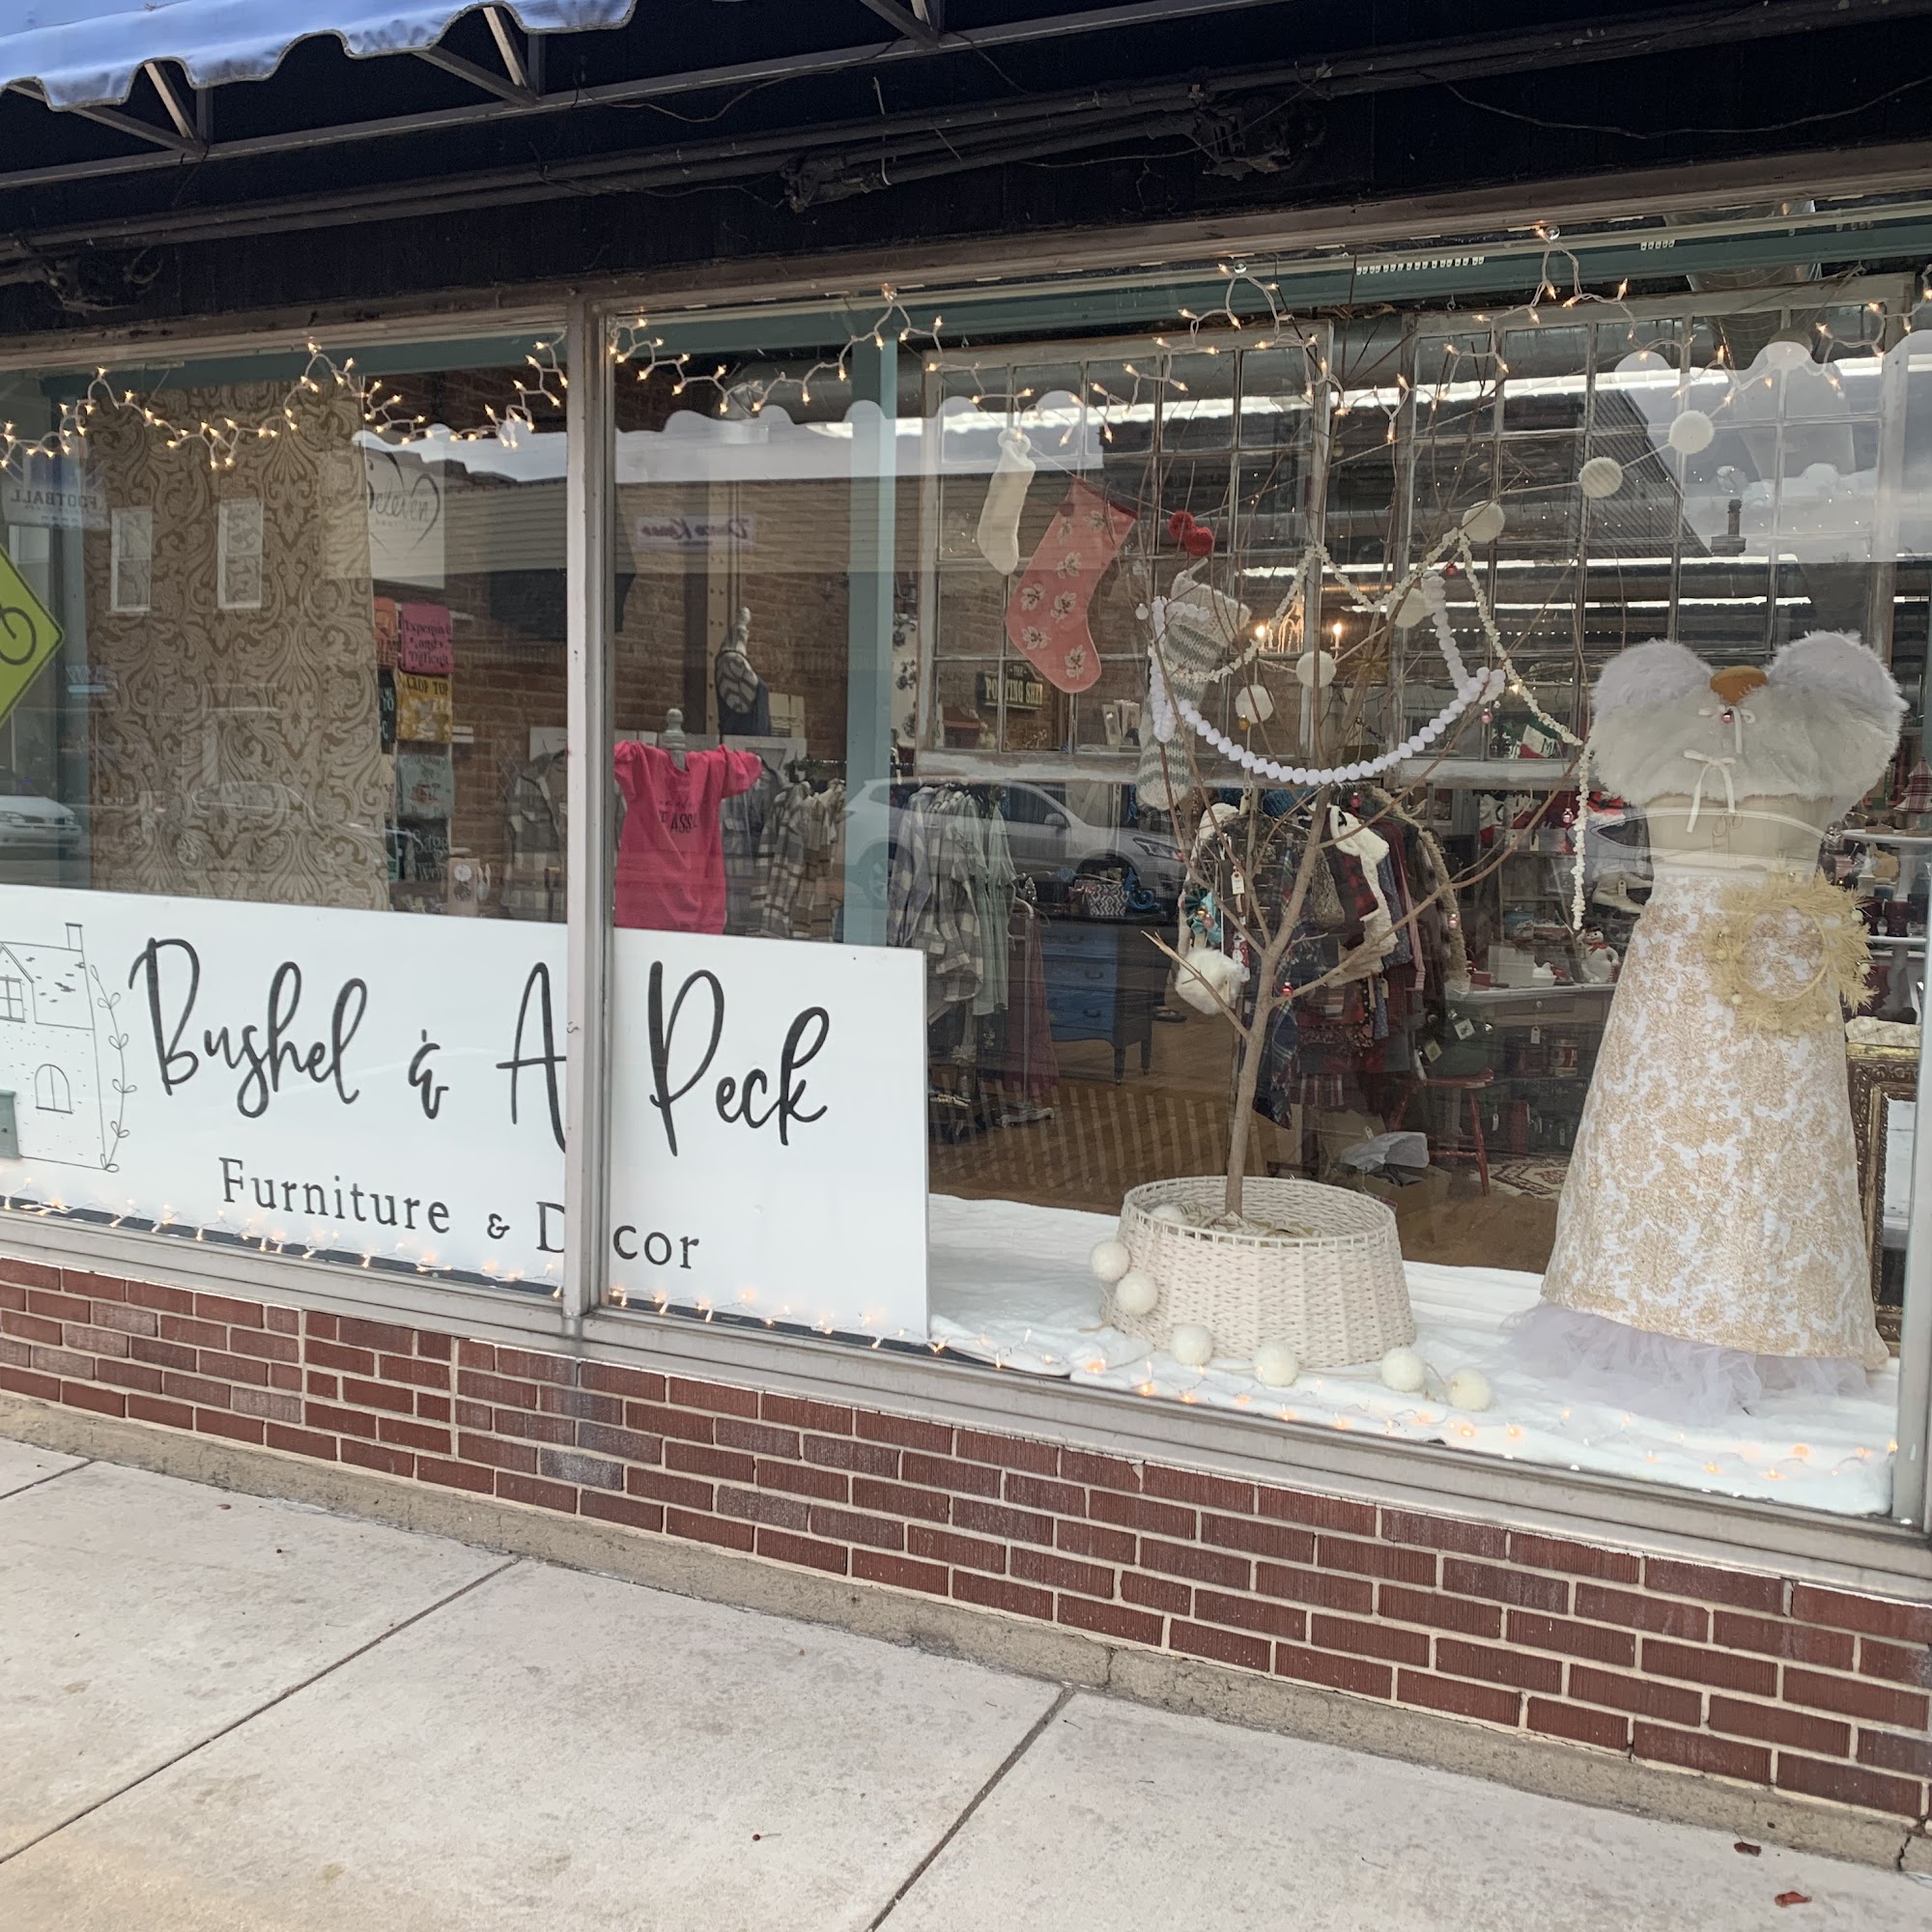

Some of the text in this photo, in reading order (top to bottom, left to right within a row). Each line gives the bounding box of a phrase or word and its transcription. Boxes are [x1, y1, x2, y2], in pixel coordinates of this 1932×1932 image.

[984, 677, 1024, 703] POTING
[128, 937, 831, 1157] Bushel & A Peck
[218, 1156, 699, 1269] Furniture & Dcor
